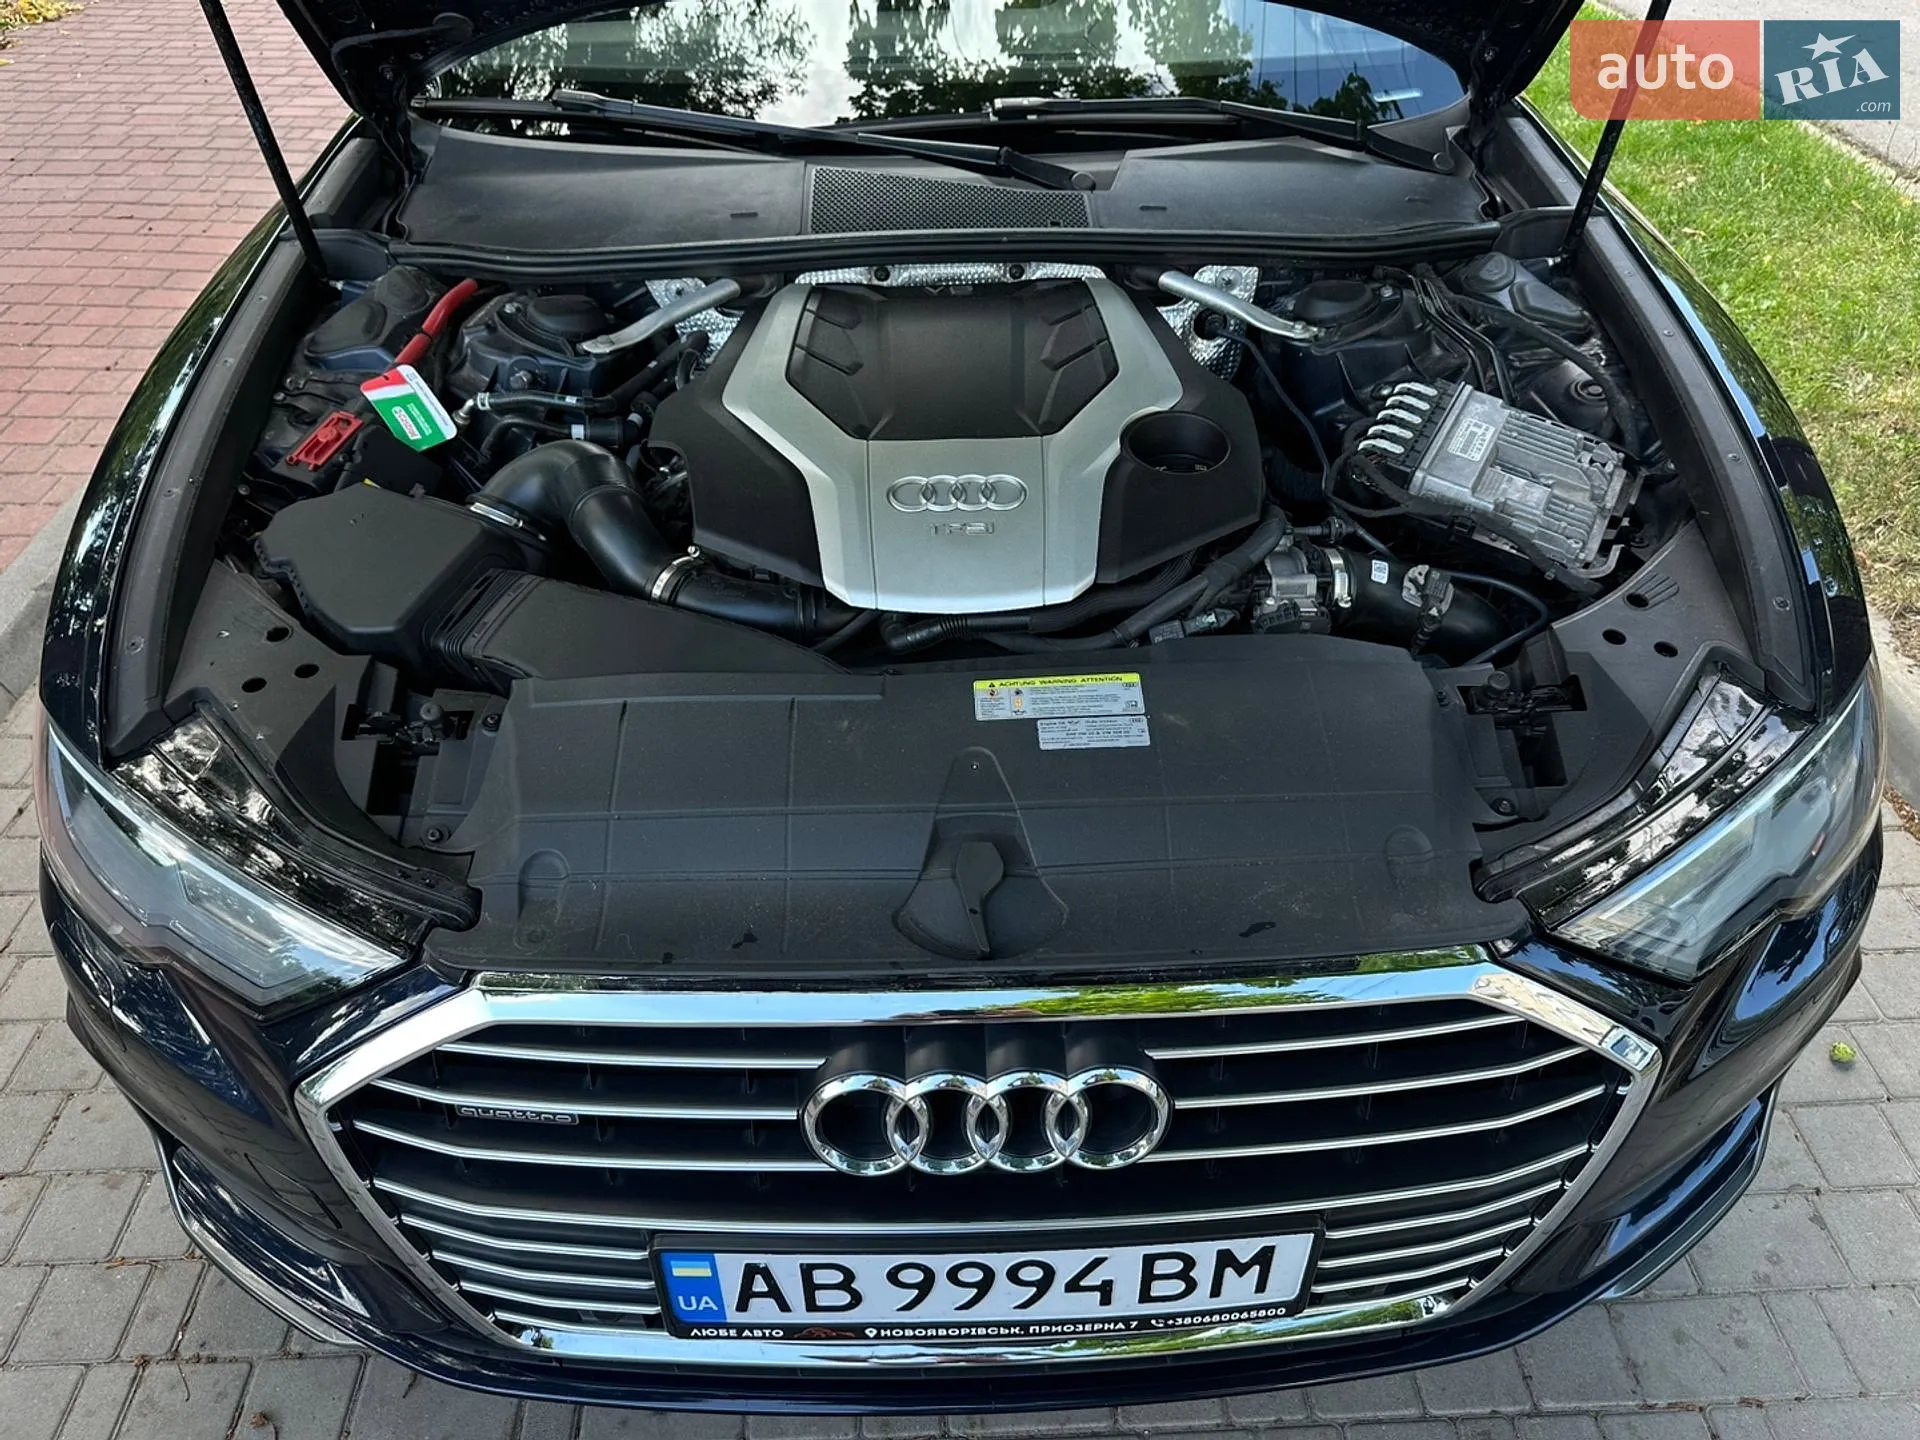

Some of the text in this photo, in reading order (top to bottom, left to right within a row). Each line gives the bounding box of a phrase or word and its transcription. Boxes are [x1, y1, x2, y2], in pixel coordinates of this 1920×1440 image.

[928, 522, 995, 537] TFSI
[998, 675, 1123, 688] ACHTUNG WARNING ATTENTION
[460, 1106, 572, 1123] quattro
[735, 1245, 1276, 1312] AB 9994 BM
[678, 1295, 718, 1311] UA
[1166, 1307, 1286, 1326] +380680065800
[690, 1328, 784, 1338] ЛЮБЕ АВТО
[1029, 1322, 1126, 1334] ПРИОЗЕРНА
[1129, 1320, 1139, 1330] 7
